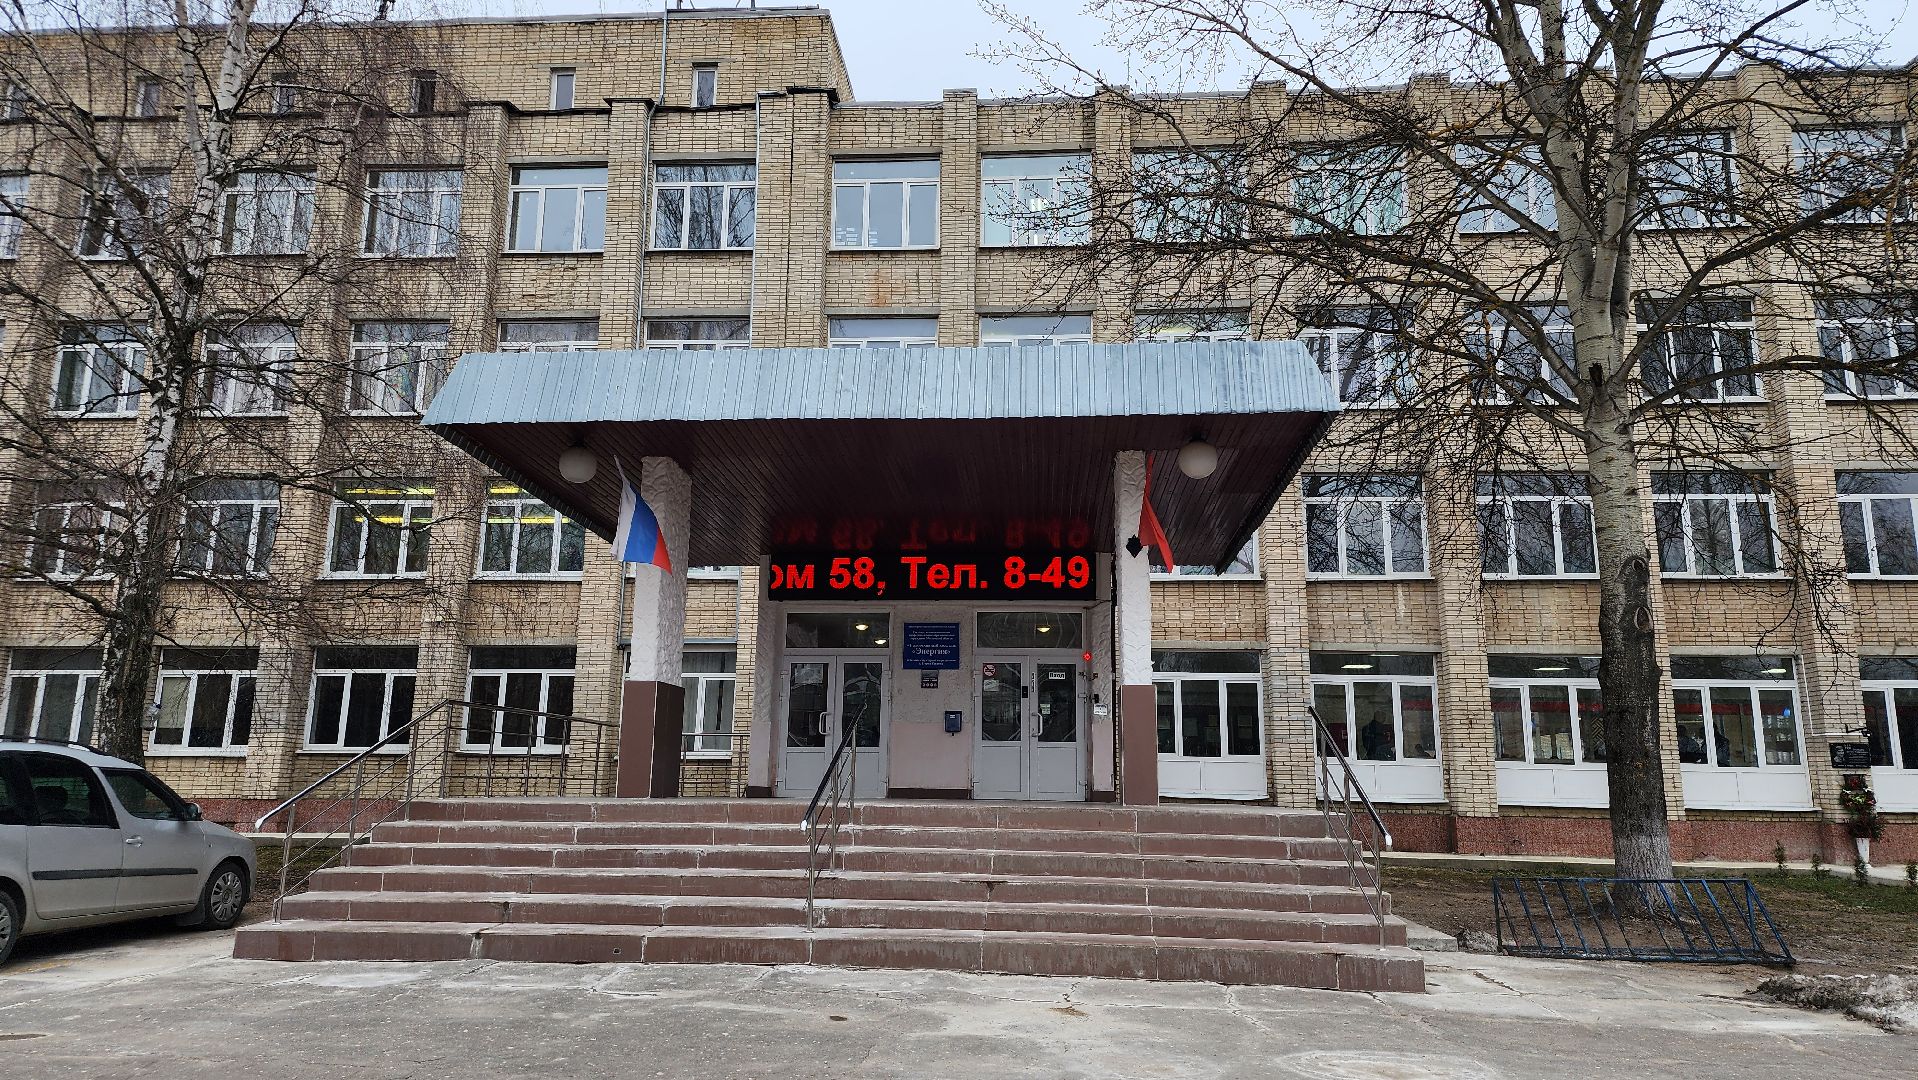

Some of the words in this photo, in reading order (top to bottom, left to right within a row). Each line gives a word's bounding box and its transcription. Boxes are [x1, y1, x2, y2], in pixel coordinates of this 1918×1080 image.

[829, 557, 886, 595] 58,
[901, 557, 988, 589] Тел.
[1003, 556, 1090, 589] 8-49
